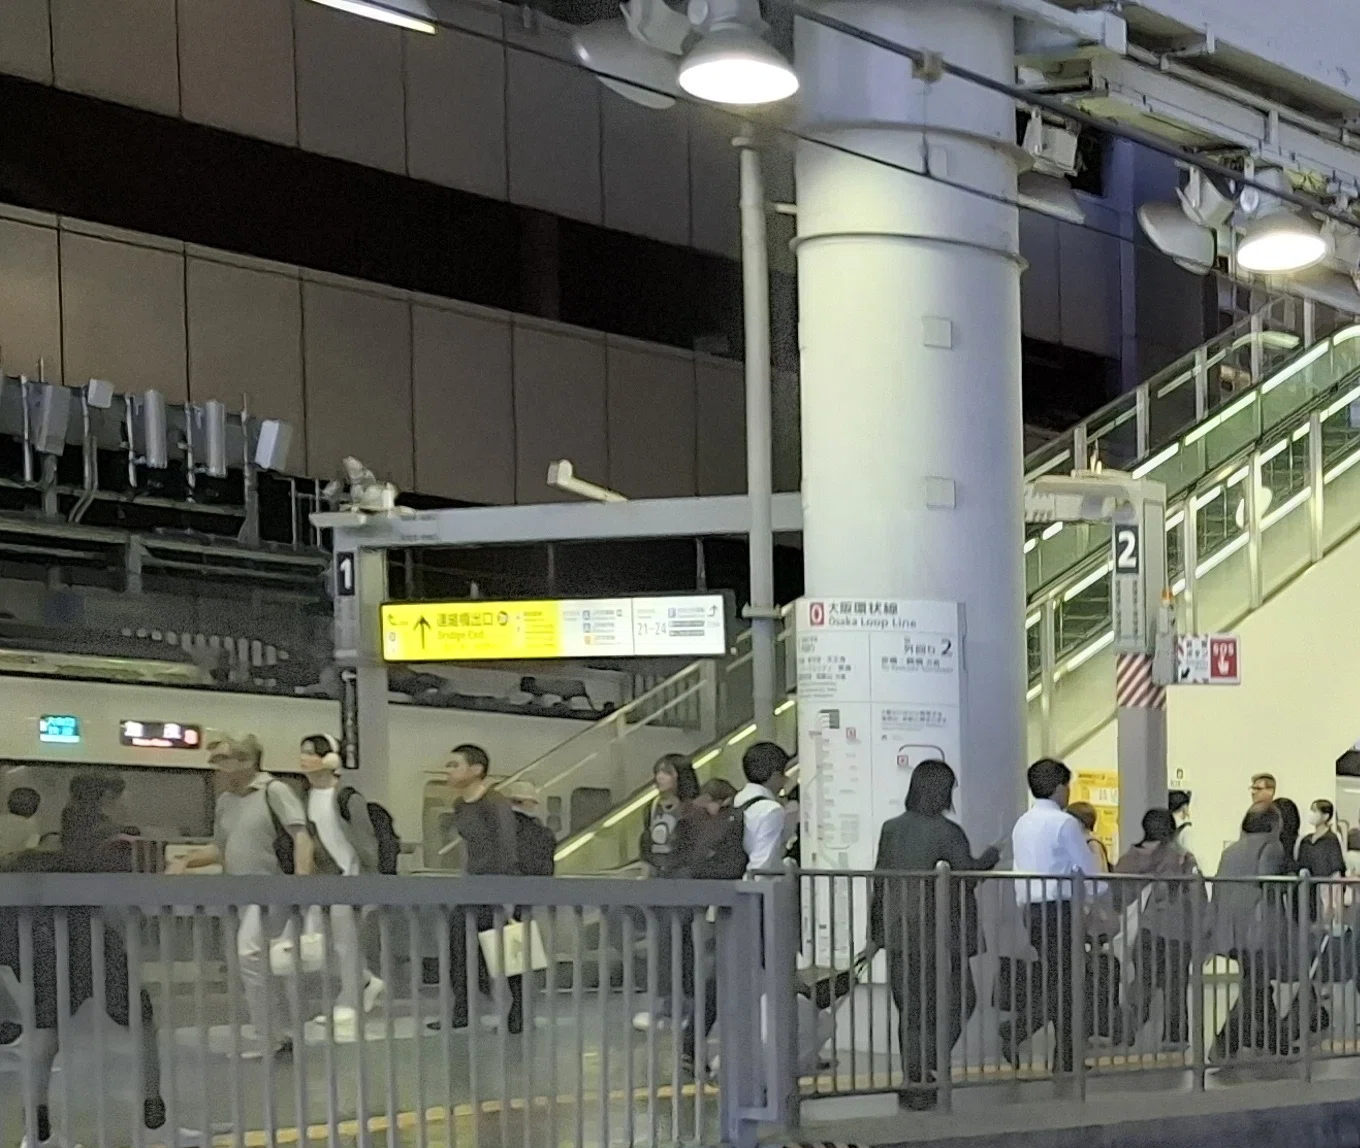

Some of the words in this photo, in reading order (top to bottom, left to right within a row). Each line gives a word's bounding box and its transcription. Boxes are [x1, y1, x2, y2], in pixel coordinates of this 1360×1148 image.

[1117, 530, 1137, 568] 2
[340, 557, 352, 590] 1
[637, 622, 668, 636] 21-24
[828, 618, 858, 627] Osaka
[860, 618, 889, 629] Loop
[892, 618, 917, 628] Line
[941, 638, 953, 656] 2
[1213, 643, 1235, 656] SOS
